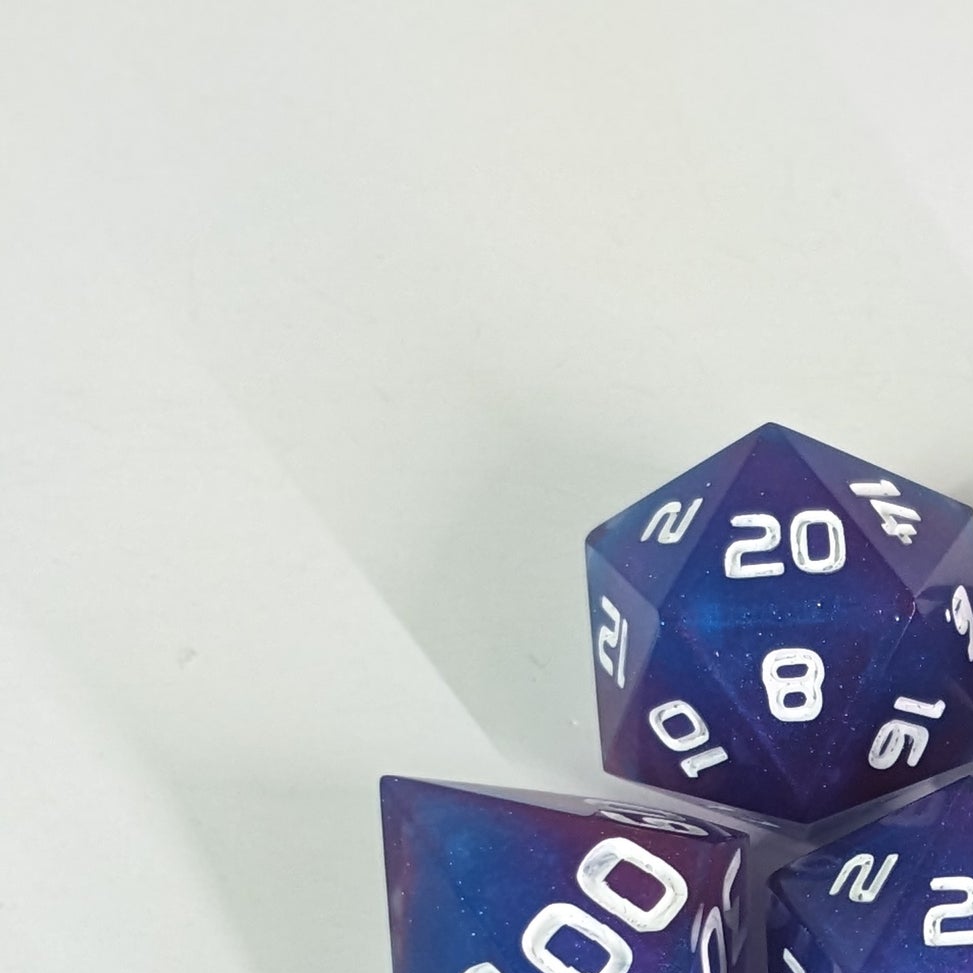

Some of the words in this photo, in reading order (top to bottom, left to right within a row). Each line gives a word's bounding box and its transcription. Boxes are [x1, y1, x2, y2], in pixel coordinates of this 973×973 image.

[640, 497, 703, 545] 2
[724, 509, 846, 579] 20
[761, 647, 825, 722] 8
[648, 699, 729, 779] 10
[868, 696, 946, 770] 16
[829, 853, 899, 903] 2
